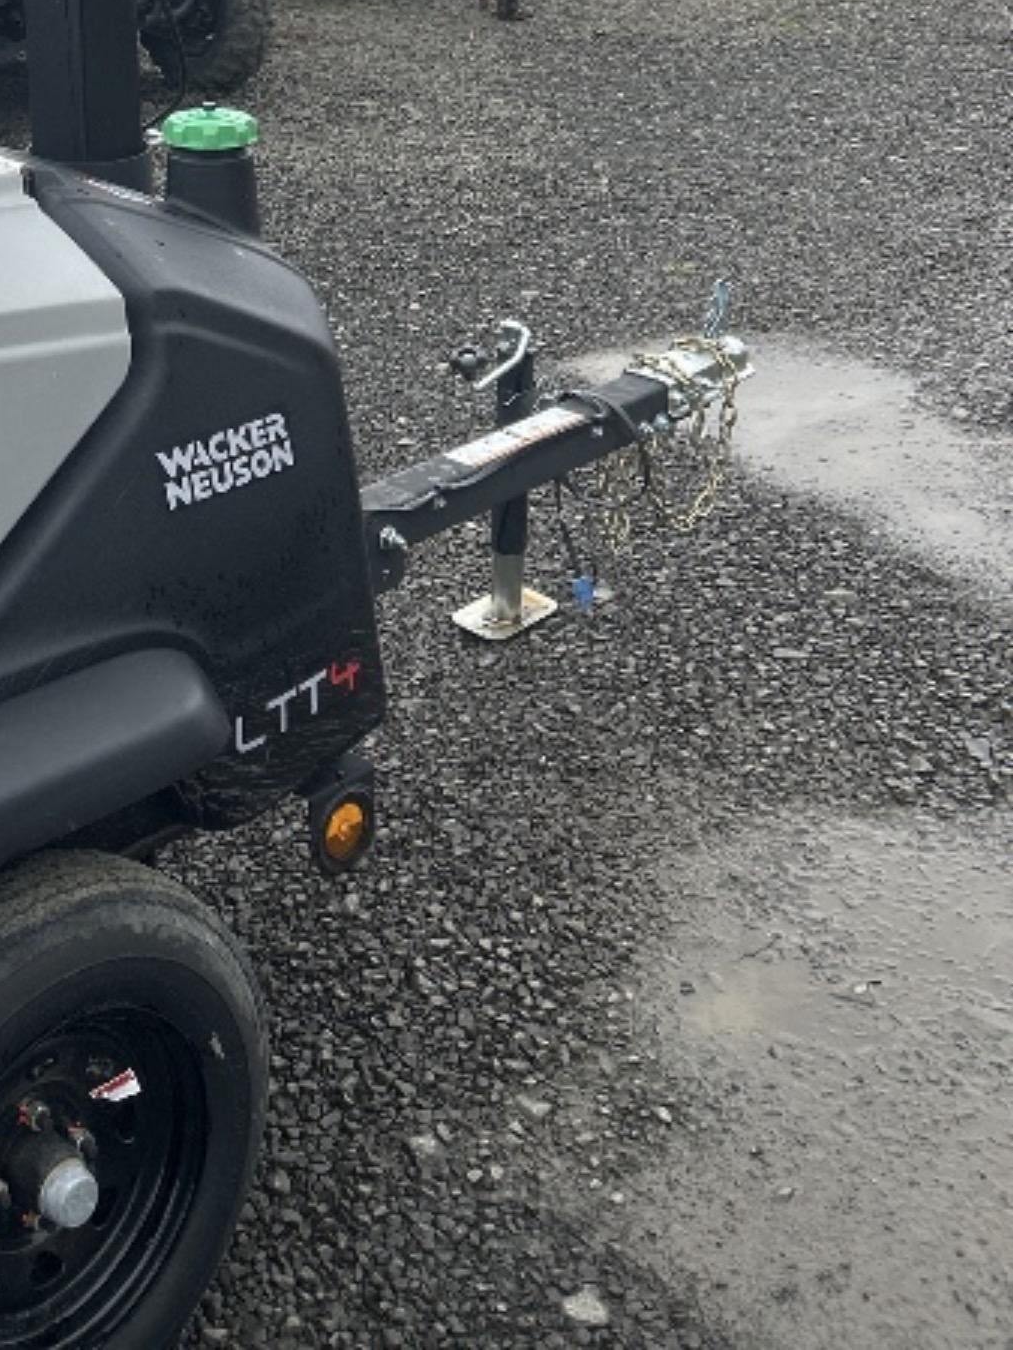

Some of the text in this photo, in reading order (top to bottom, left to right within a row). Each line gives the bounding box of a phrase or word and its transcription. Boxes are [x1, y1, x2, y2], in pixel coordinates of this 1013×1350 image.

[154, 413, 288, 478] WACKER
[164, 439, 295, 511] NEUSON
[234, 661, 361, 754] LTT4
